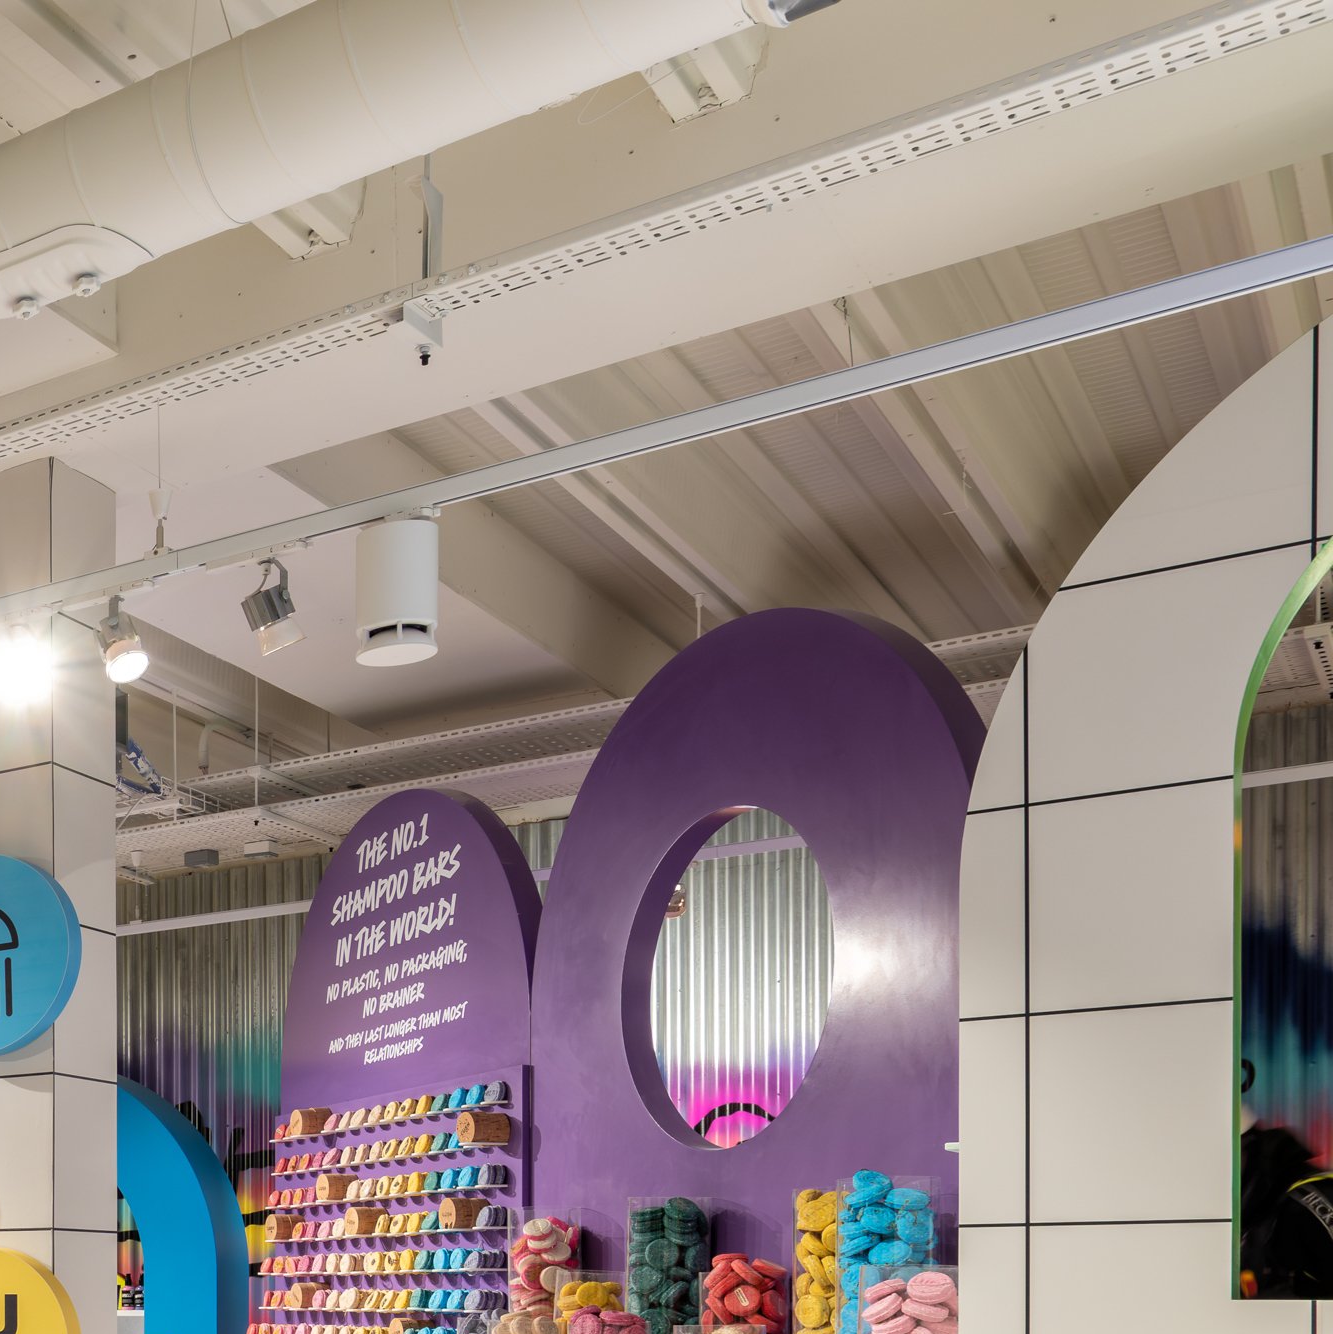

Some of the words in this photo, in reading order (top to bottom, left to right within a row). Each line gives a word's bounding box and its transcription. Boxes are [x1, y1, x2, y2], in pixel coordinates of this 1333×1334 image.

[356, 831, 388, 874] THE
[390, 813, 430, 860] NO.1
[330, 869, 409, 926] SHAMPOO
[412, 844, 462, 895] BARS
[335, 933, 352, 968] IN
[354, 920, 386, 960] THE
[389, 893, 457, 947] WORLD!
[326, 983, 339, 1004] NO
[341, 969, 381, 998] PLASTIC,
[384, 963, 399, 986] NO
[362, 997, 377, 1019] NO
[379, 982, 425, 1014] BRAINER
[328, 1037, 344, 1054] AND
[345, 1031, 364, 1050] THEY
[364, 1024, 385, 1045] LAST
[384, 1017, 417, 1039] LONGER
[418, 1009, 441, 1030] THAN
[442, 1001, 468, 1023] MOST
[364, 1036, 424, 1065] RELATIONSHIPS
